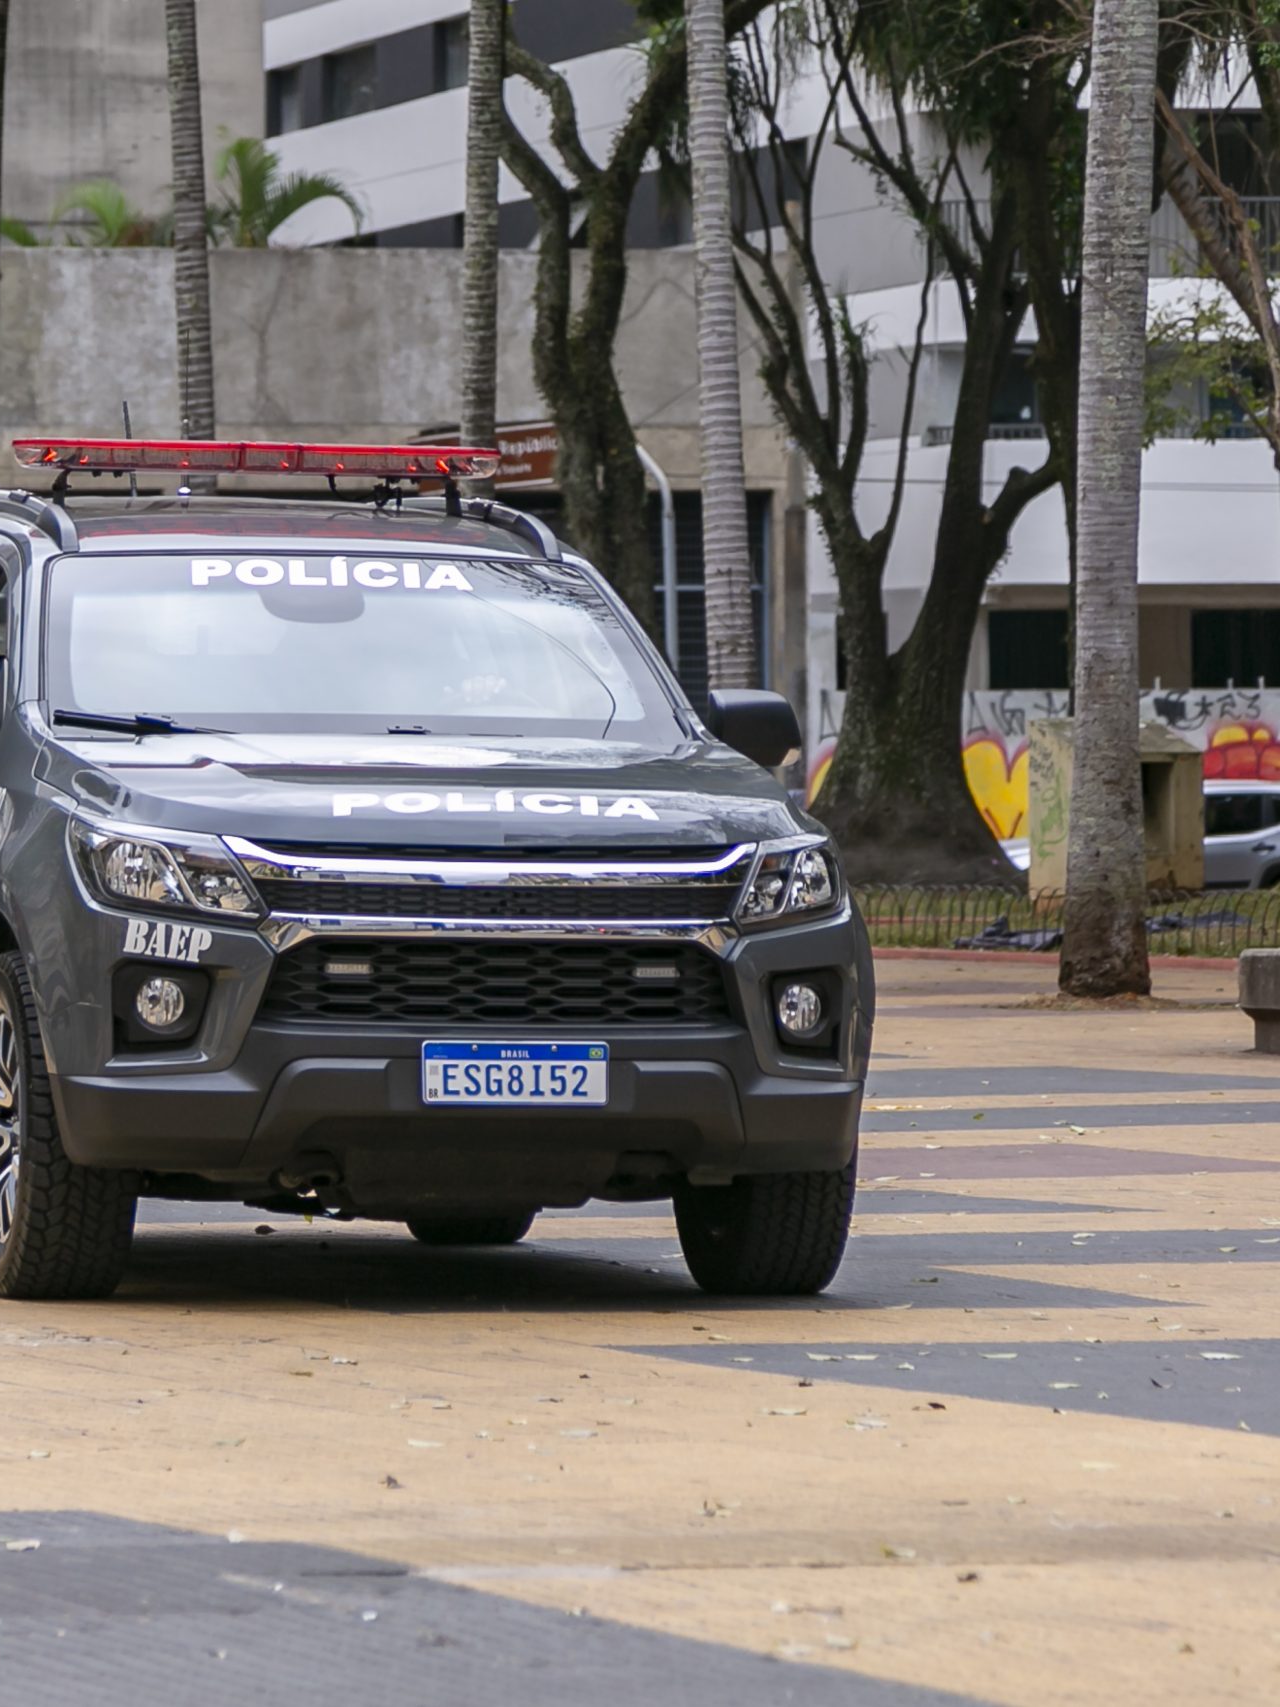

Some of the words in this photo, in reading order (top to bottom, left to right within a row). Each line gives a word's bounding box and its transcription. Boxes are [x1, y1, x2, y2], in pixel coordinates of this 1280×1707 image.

[499, 435, 558, 456] Repúblic
[191, 556, 474, 591] POLÍCIA
[332, 789, 660, 821] POLÍCIA
[123, 918, 213, 963] BAEP
[500, 1050, 530, 1059] BRASIL
[428, 1088, 439, 1099] BR
[442, 1063, 588, 1098] ESG8I52
